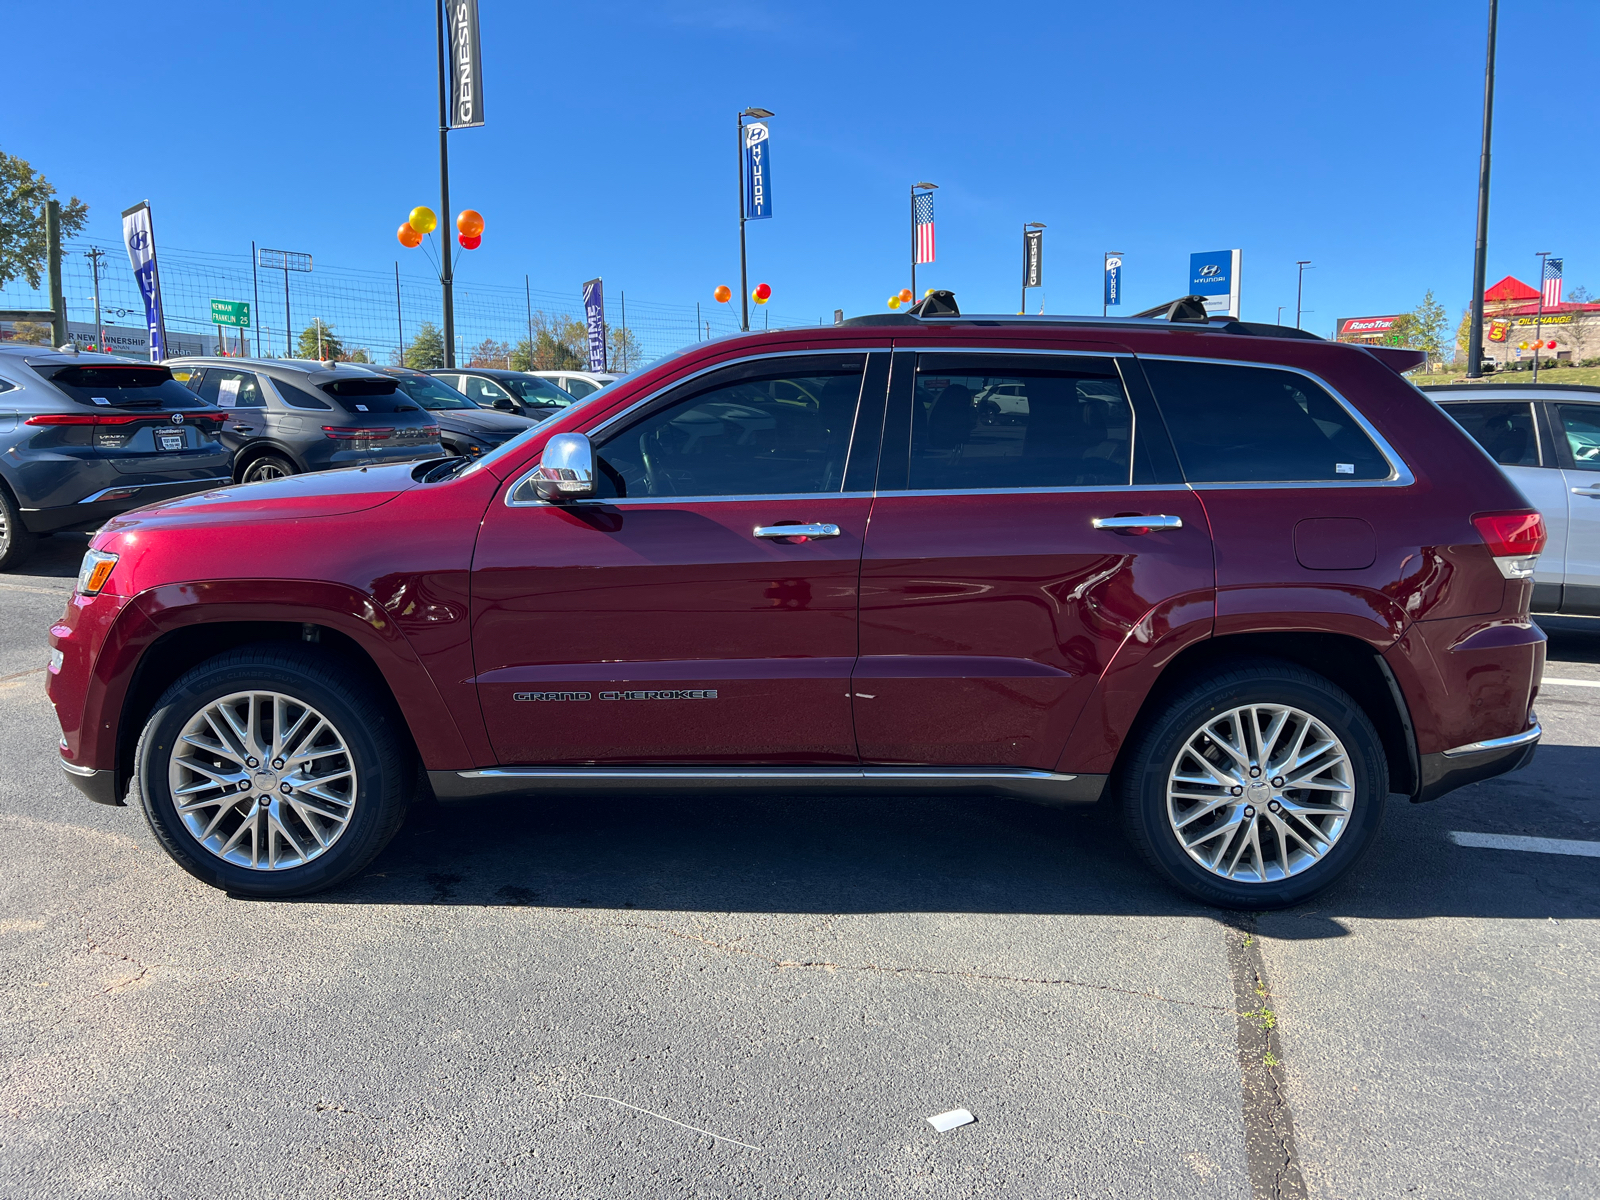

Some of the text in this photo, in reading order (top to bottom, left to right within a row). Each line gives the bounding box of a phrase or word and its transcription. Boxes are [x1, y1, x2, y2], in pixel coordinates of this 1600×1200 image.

[457, 3, 472, 122] GENESIS
[753, 144, 763, 215] HYUNDAI
[1030, 238, 1038, 285] GENESIS
[212, 303, 248, 314] NEWNAN 4
[212, 312, 248, 325] FRANKLIN 25
[1532, 316, 1572, 324] CHANGE
[77, 333, 96, 341] NEW
[1490, 328, 1503, 339] 5
[227, 671, 272, 679] CLIMBER
[513, 690, 718, 701] GRAND CHEROKEE
